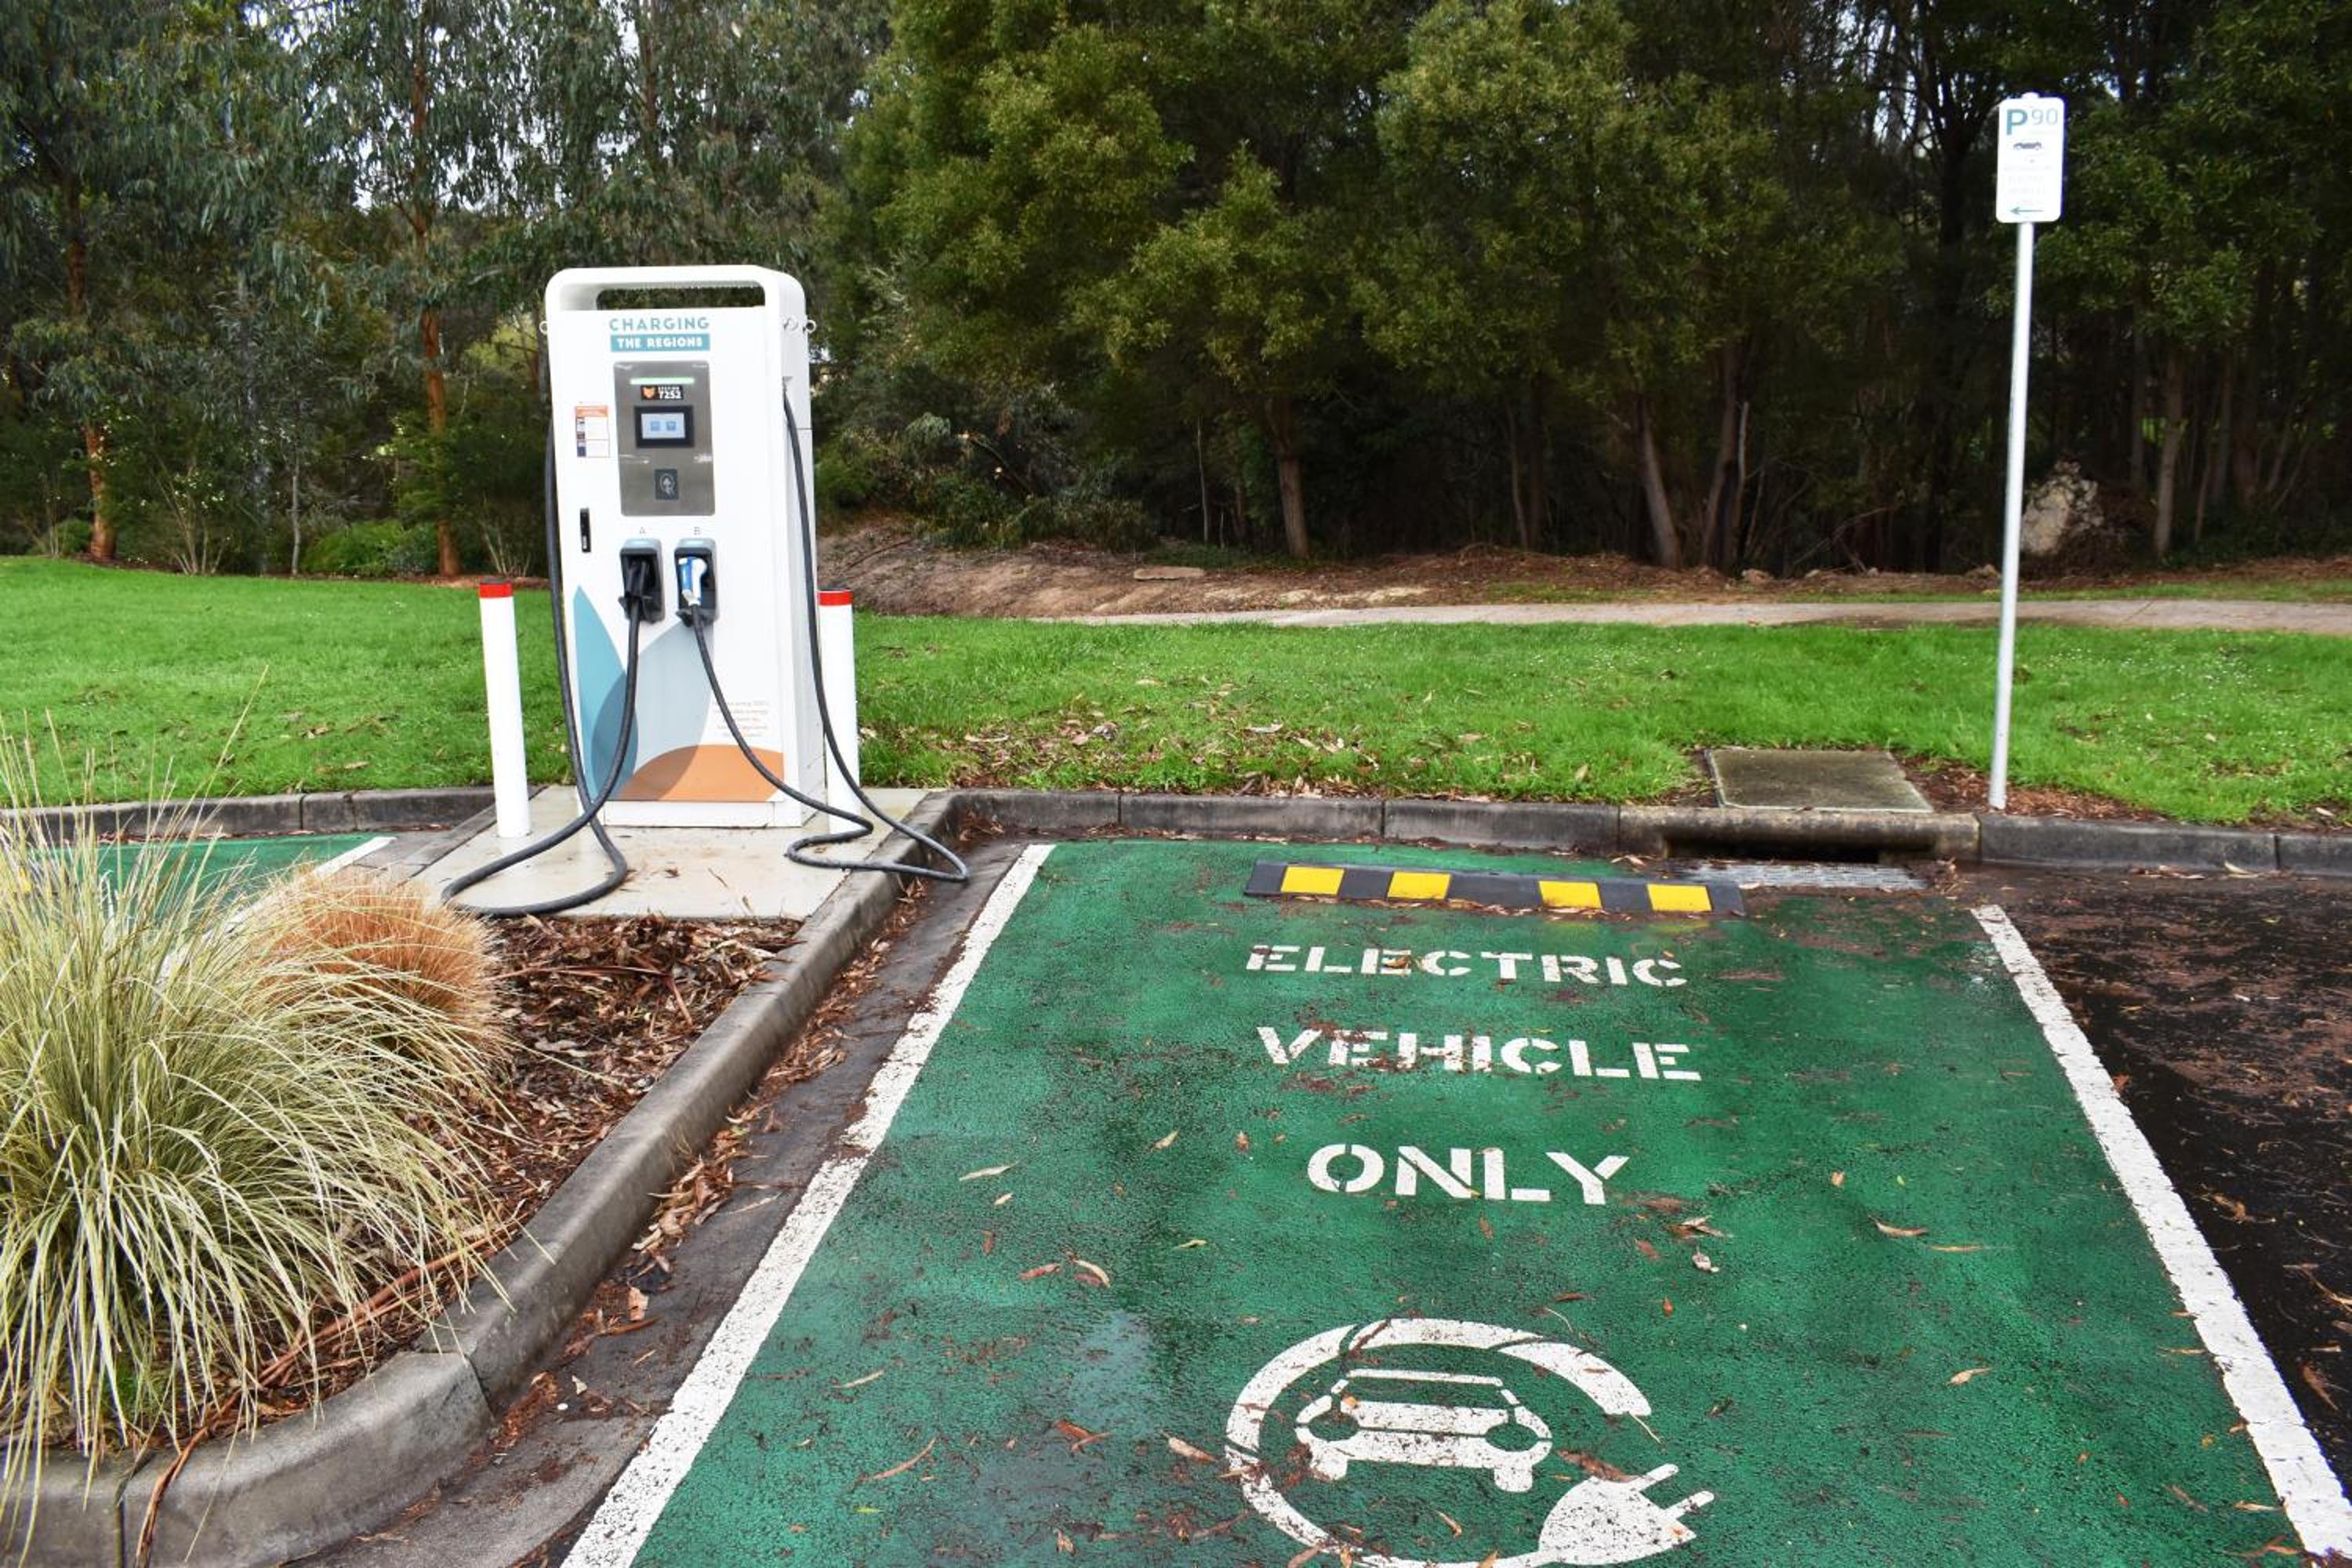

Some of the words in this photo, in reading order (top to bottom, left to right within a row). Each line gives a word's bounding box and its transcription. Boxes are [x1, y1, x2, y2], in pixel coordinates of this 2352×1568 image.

[608, 317, 710, 332] CHARGING
[616, 337, 641, 348] THE
[647, 336, 702, 347] REGIONS
[639, 526, 646, 535] A
[693, 526, 702, 535] B
[1246, 945, 1688, 988] ELECTRIC
[1256, 1026, 1702, 1081] VEHICLE
[1307, 1144, 1630, 1205] ONLY
